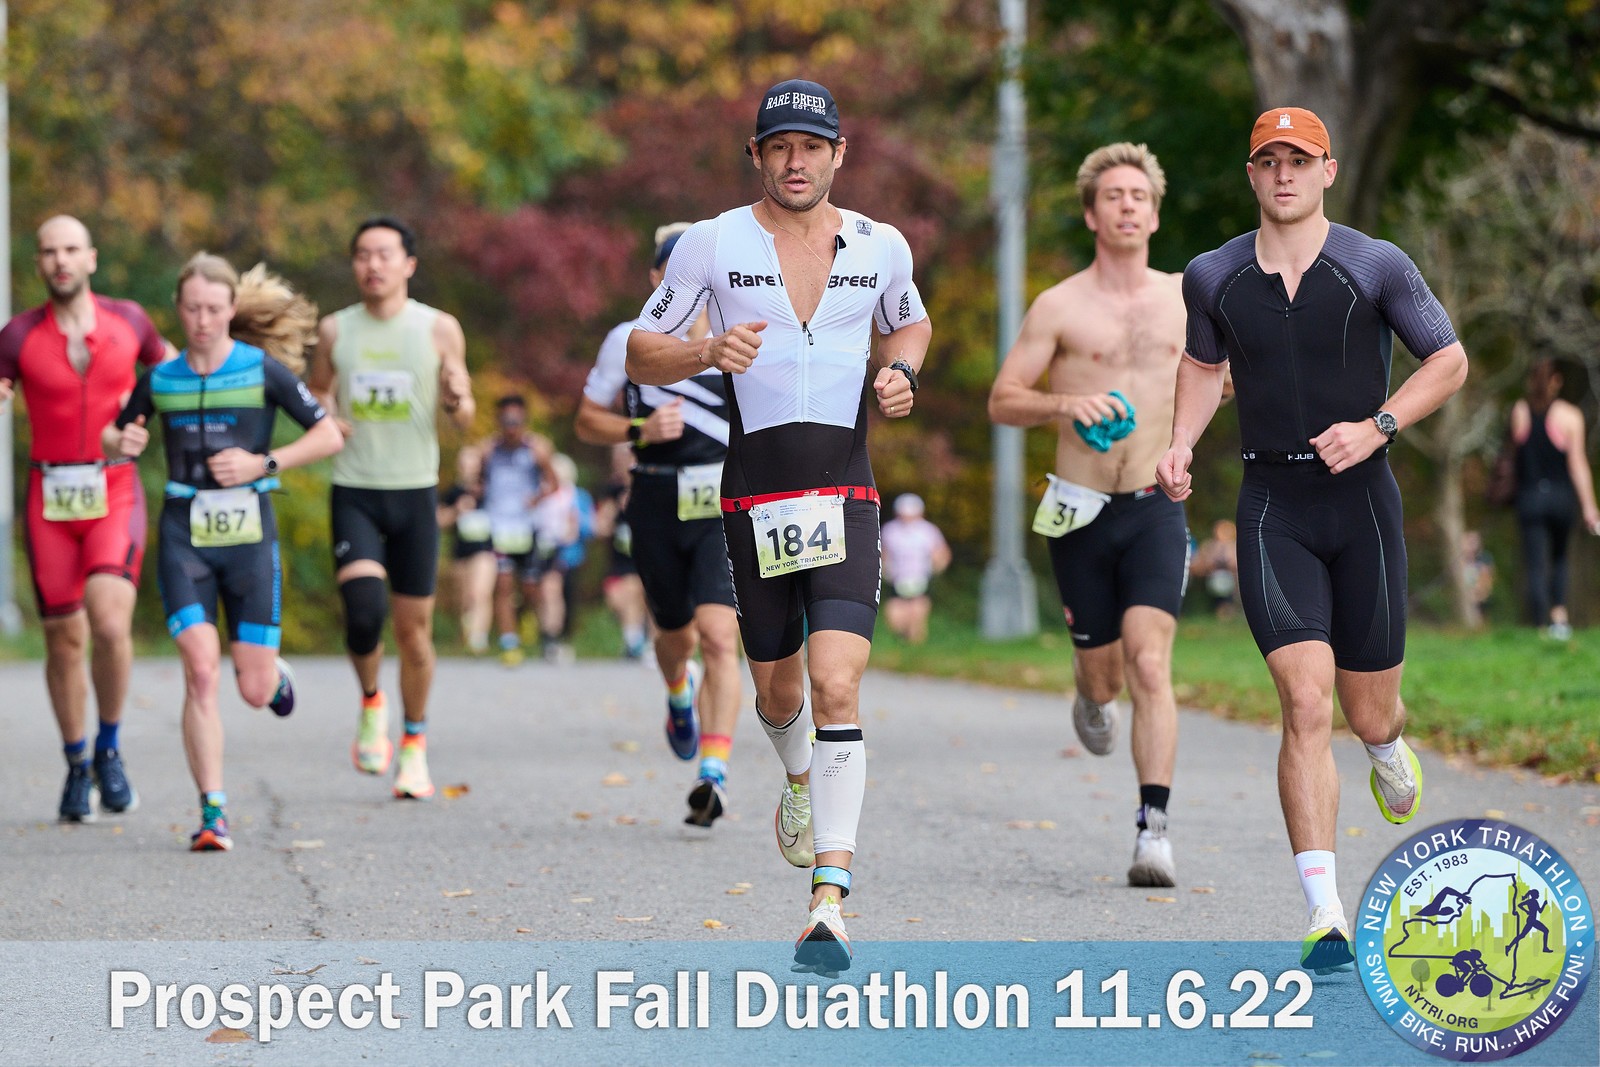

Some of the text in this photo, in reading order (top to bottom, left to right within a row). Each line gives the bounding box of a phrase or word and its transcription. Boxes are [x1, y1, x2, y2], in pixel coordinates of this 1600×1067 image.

[765, 92, 826, 110] RARE BREED
[728, 271, 878, 289] Rare Breed
[1331, 267, 1349, 285] HUUB
[650, 286, 676, 321] BEAST
[899, 290, 911, 322] MODE
[203, 508, 246, 534] 187
[1053, 501, 1078, 528] 31
[766, 521, 832, 561] 184
[766, 563, 781, 572] NEW
[783, 559, 799, 568] YORK
[800, 553, 839, 564] TRIATHLON
